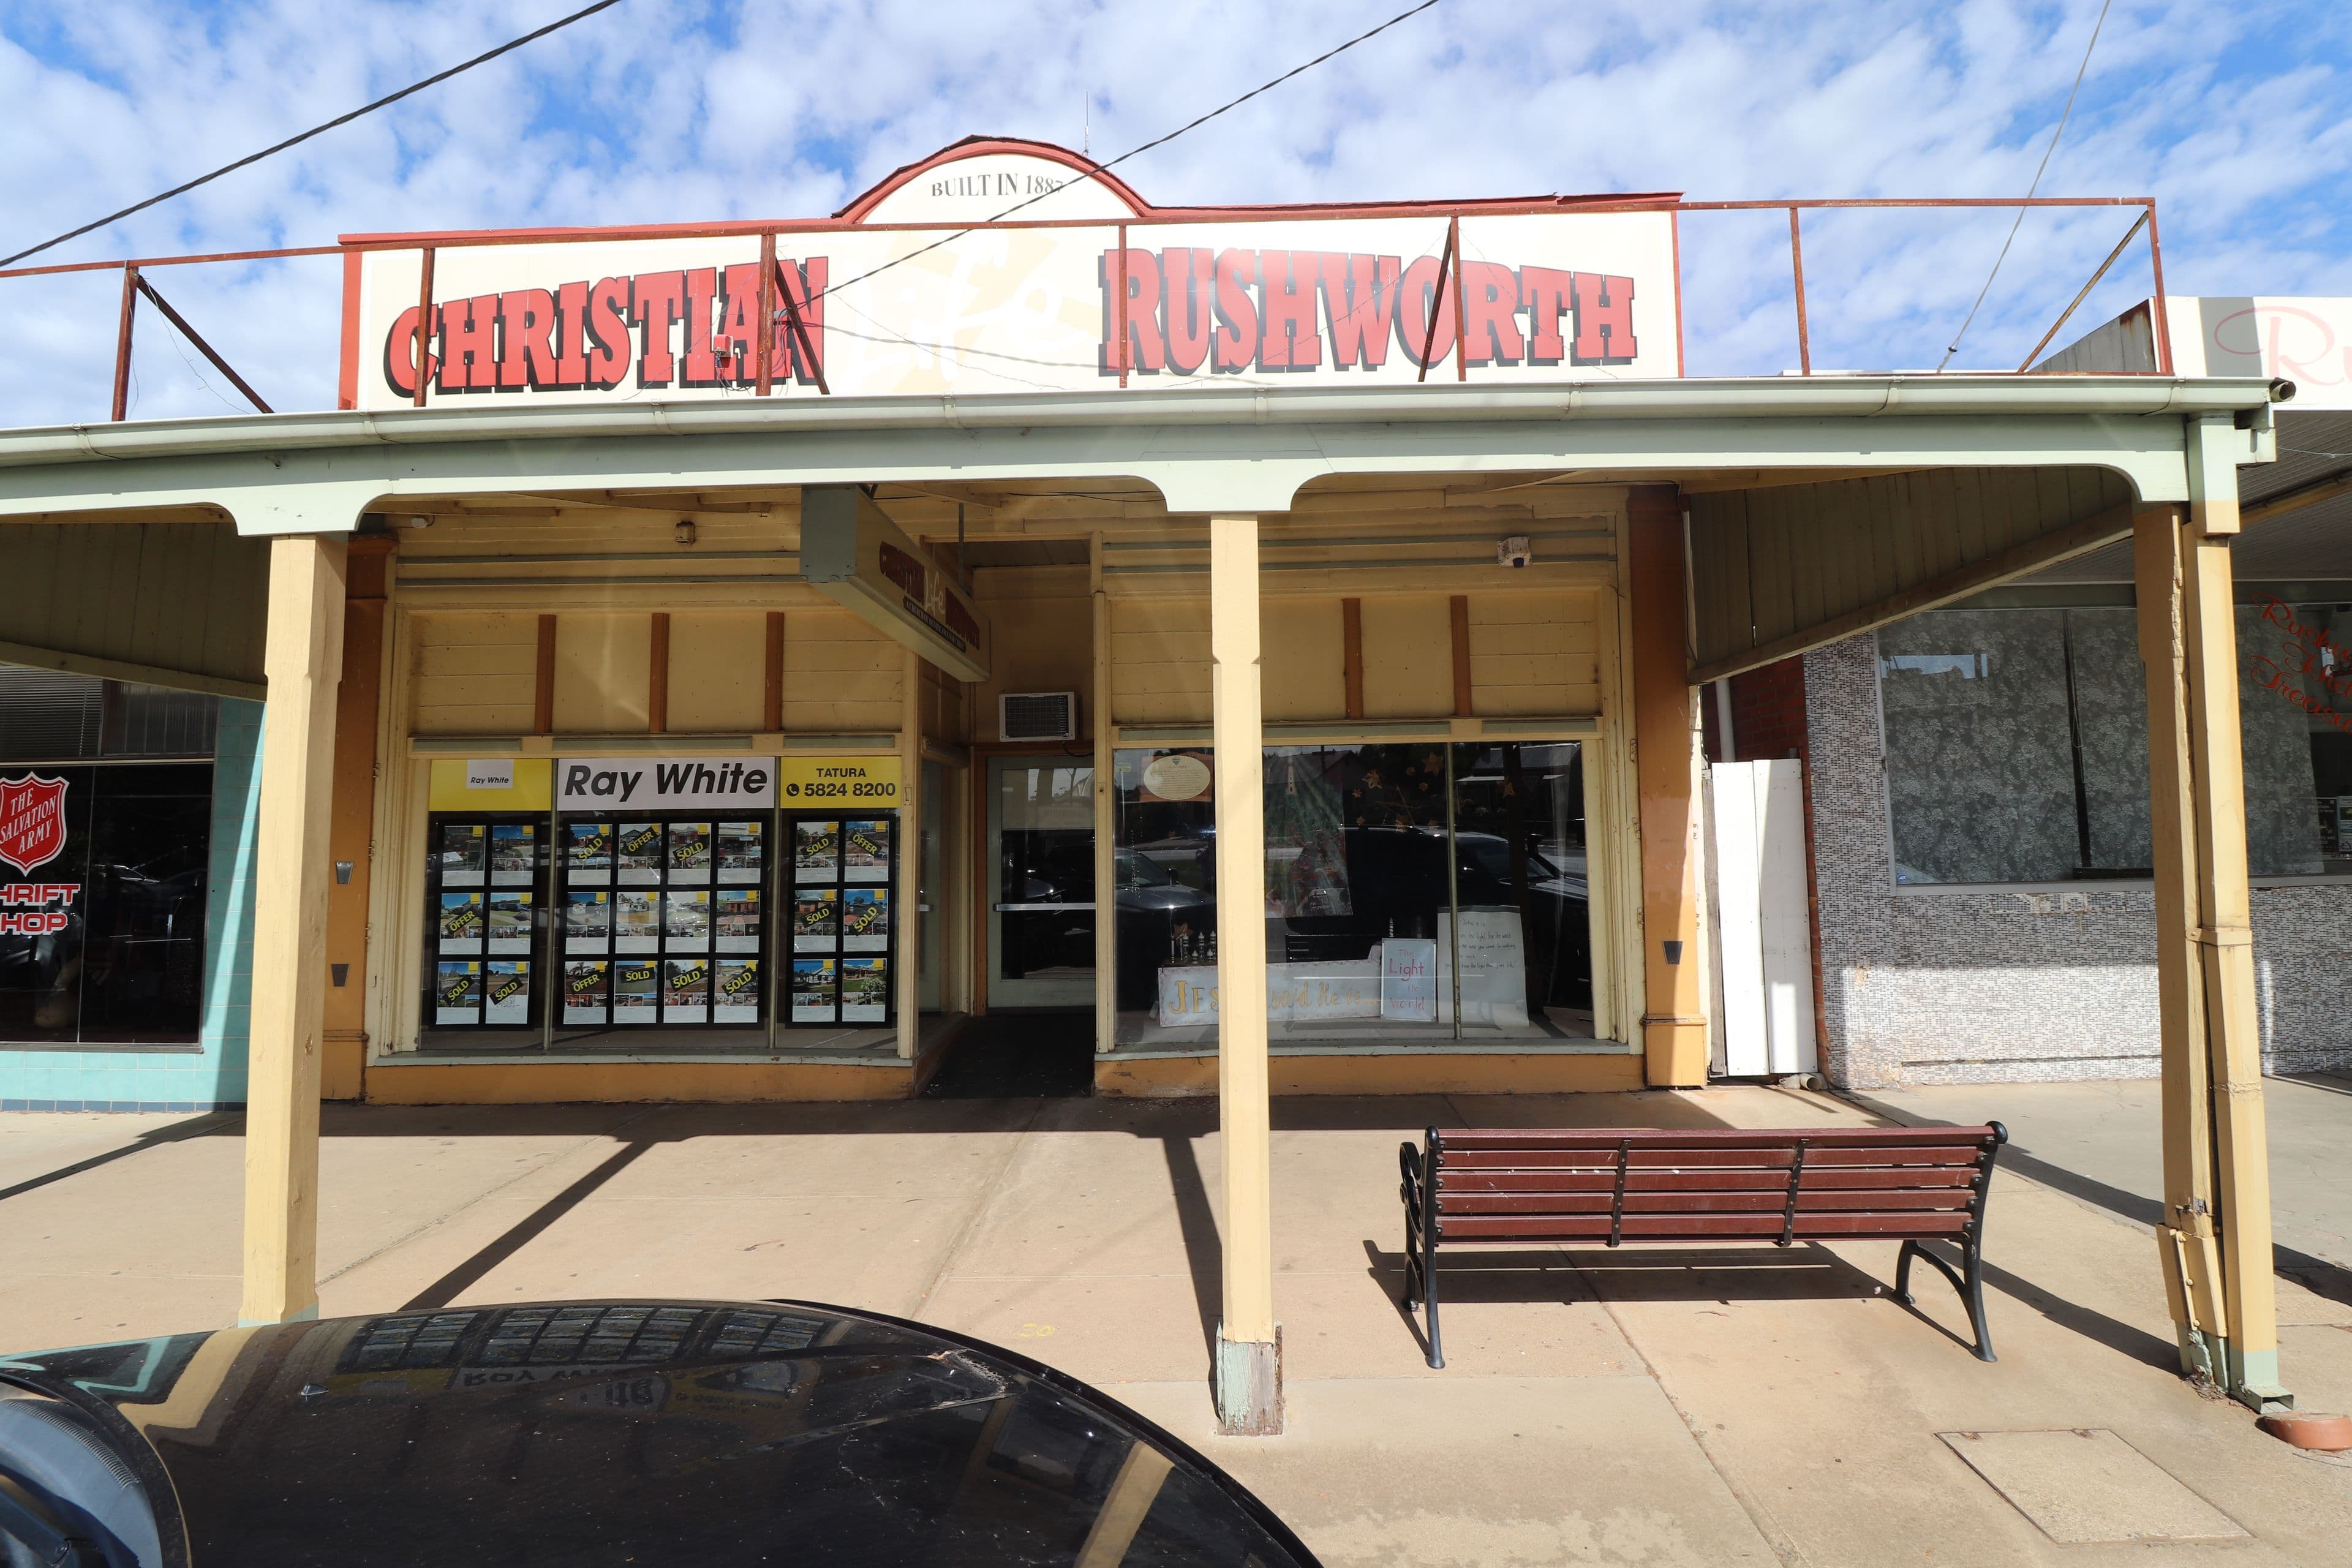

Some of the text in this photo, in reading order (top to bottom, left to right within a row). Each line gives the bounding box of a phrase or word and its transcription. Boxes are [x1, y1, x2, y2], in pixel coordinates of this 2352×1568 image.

[932, 173, 1063, 197] BUILT IN 1887
[383, 257, 828, 398] CHRISTIAN
[1099, 247, 1638, 376] RUSHWORTH
[564, 763, 768, 802] Ray White
[816, 767, 867, 778] TATURA
[804, 782, 896, 797] 5824 8200
[10, 787, 34, 816] THE
[0, 795, 58, 845] SALVATION
[17, 818, 54, 855] ARMY
[628, 831, 654, 852] OFFER
[806, 838, 829, 856] SOLD
[852, 833, 877, 854] OFFER
[578, 837, 603, 861] SOLD
[676, 842, 704, 861] SOLD
[449, 910, 475, 932] OFFER
[806, 908, 829, 925] SOLD
[854, 907, 878, 932] SOLD
[625, 971, 650, 981] SOLD
[673, 971, 701, 989] SOLD
[1389, 958, 1424, 982] Light
[448, 981, 469, 1001] SOLD
[495, 982, 518, 1001] SOLD
[573, 974, 600, 992] OFFER
[725, 972, 752, 993] SOLD
[1169, 980, 1219, 1014] JES
